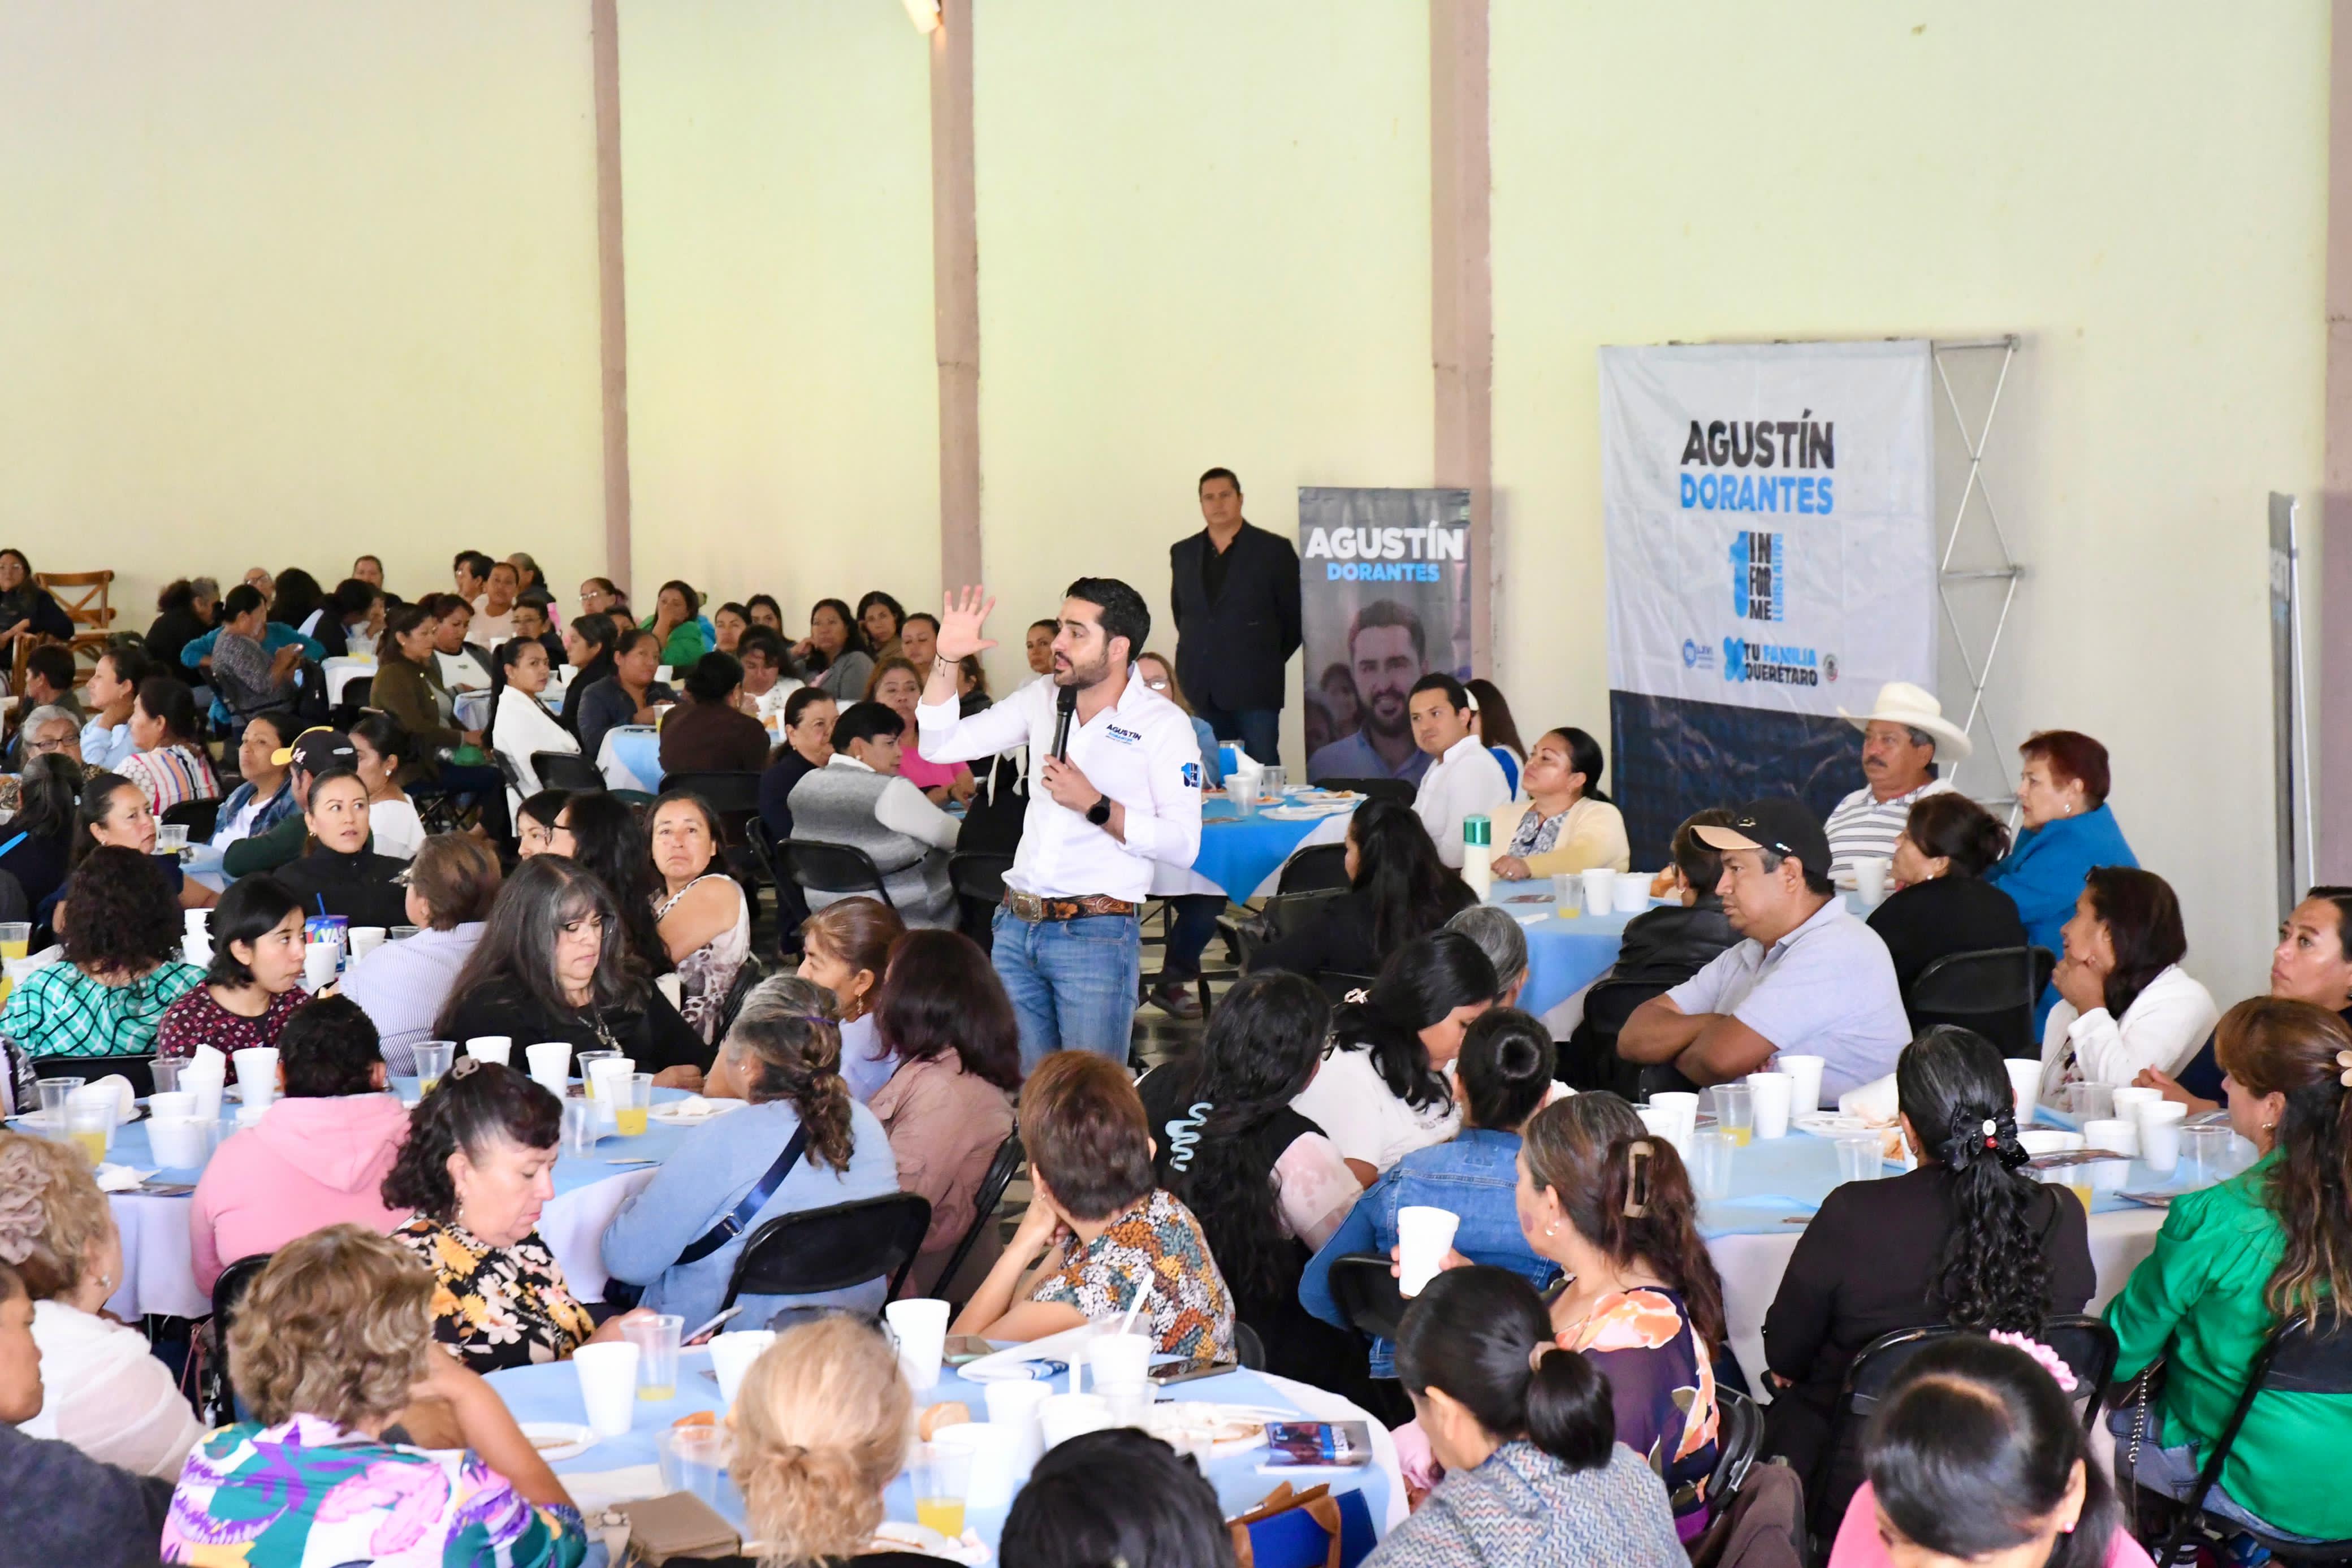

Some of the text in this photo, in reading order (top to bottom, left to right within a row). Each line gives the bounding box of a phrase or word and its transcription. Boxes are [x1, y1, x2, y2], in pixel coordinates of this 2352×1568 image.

[1680, 408, 1834, 469] AGUSTÍN
[1680, 473, 1834, 515] DORANTES
[1305, 519, 1464, 560] AGUSTÍN
[1749, 532, 1772, 564] IN
[1327, 563, 1440, 582] DORANTES
[1749, 565, 1772, 597] FOR
[1749, 599, 1772, 621] ME
[1744, 643, 1817, 667] TU FAMILIA
[1745, 662, 1818, 687] QUERÉTARO
